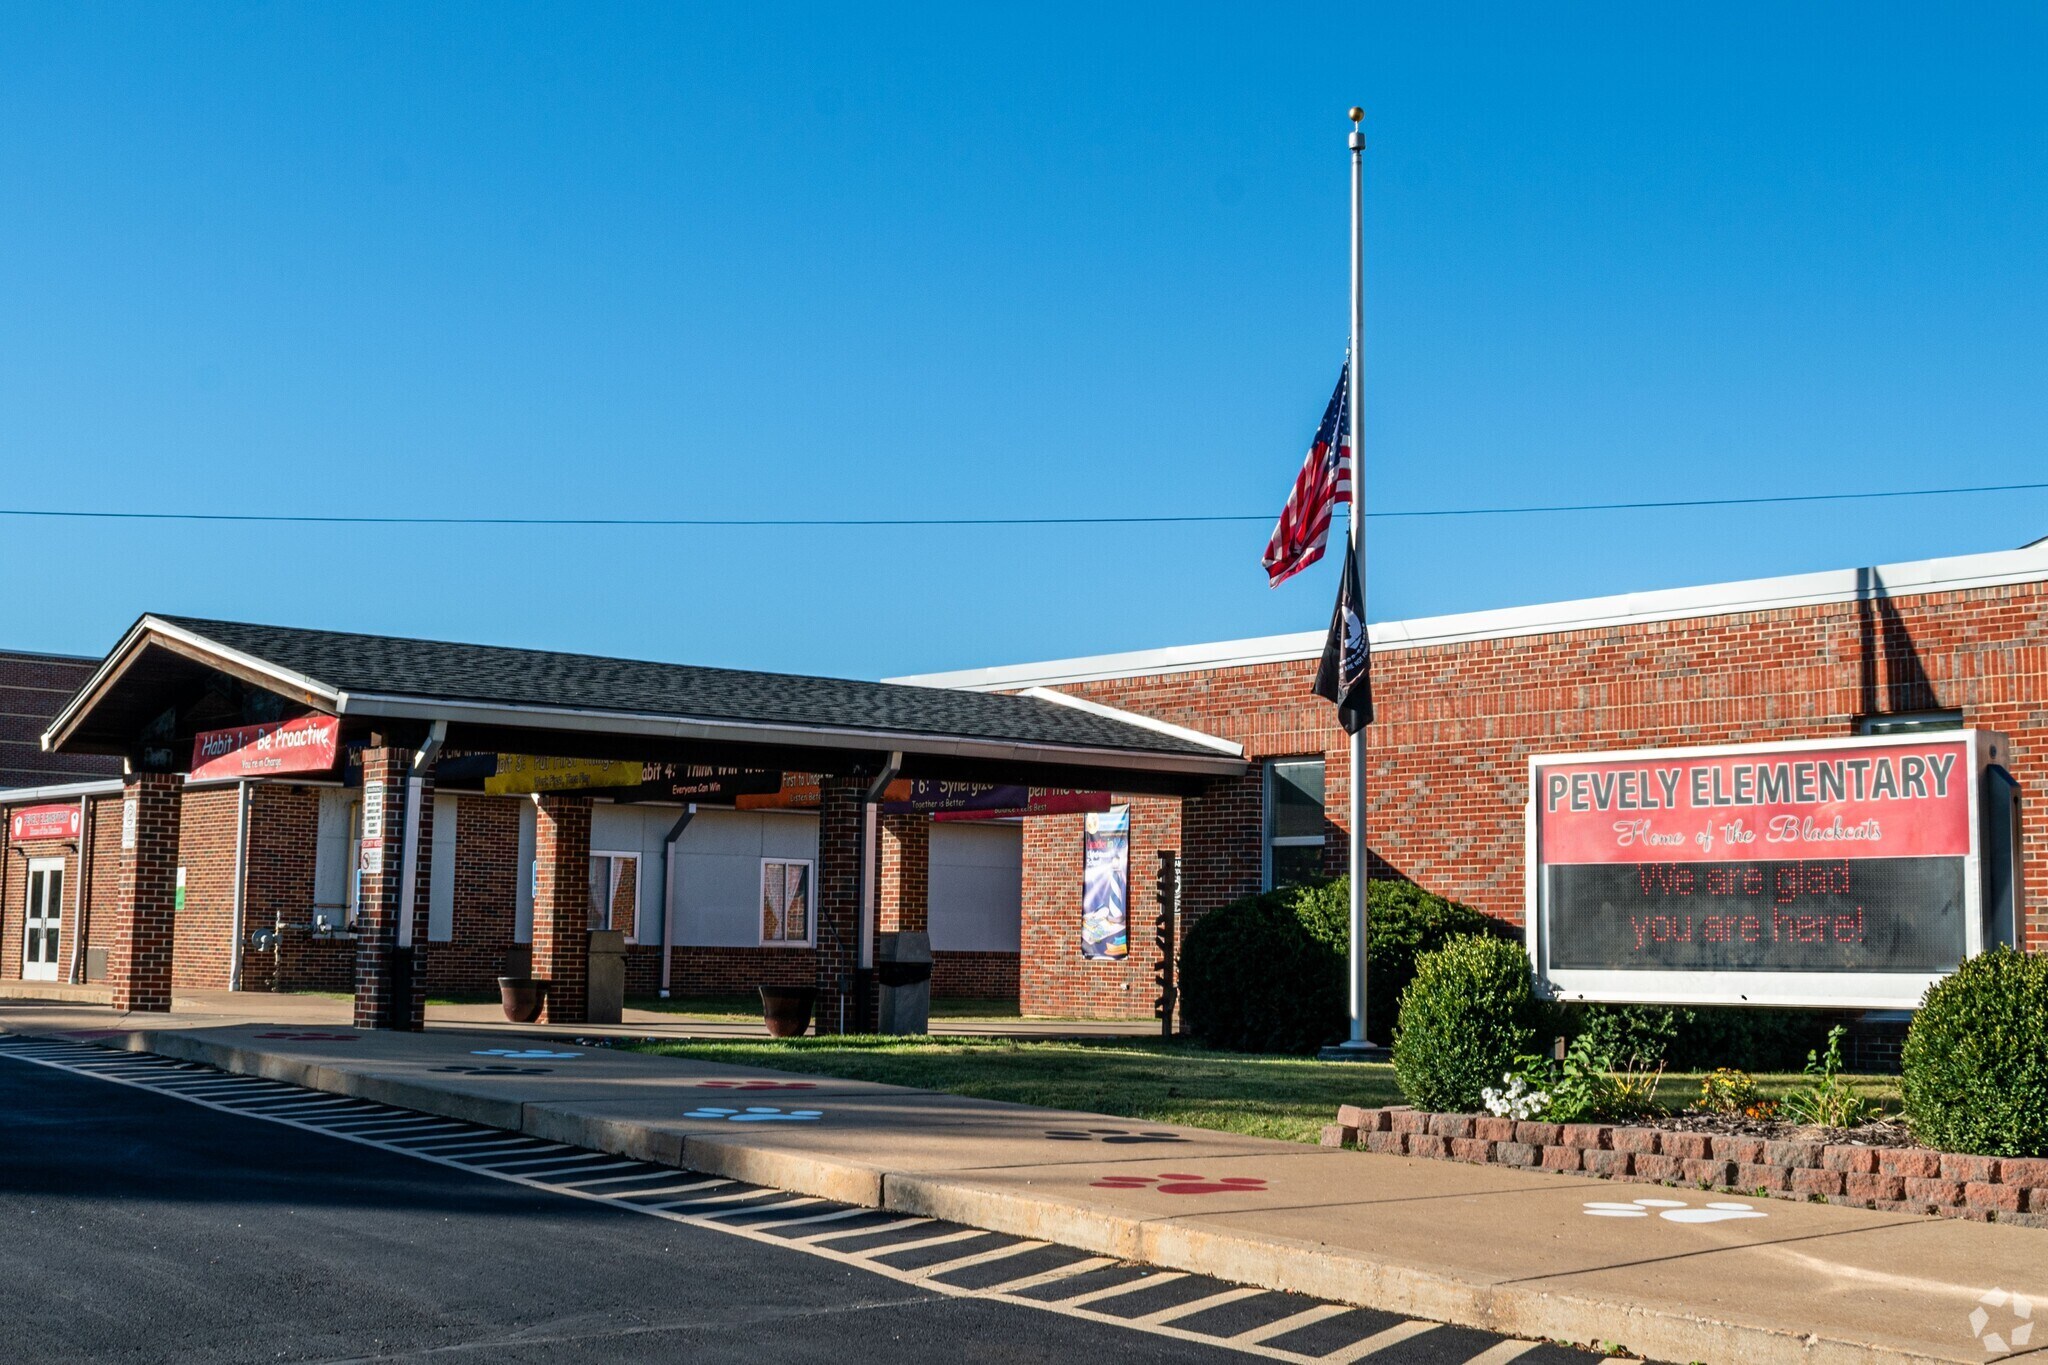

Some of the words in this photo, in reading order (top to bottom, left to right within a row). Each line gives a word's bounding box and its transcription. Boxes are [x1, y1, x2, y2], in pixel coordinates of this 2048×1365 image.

[201, 734, 233, 756] Habit
[237, 730, 248, 752] 1:
[257, 727, 271, 751] Be
[275, 722, 330, 748] Proactive
[264, 757, 282, 768] Charge
[641, 762, 662, 781] abit
[672, 784, 698, 797] Everyone
[698, 782, 708, 793] Can
[709, 781, 721, 792] Win
[1548, 768, 1681, 812] PEVELY
[1691, 753, 1956, 807] ELEMENTARY
[912, 799, 937, 810] Together
[945, 798, 966, 808] Better
[1034, 803, 1048, 812] Best
[1613, 819, 1686, 846] Home
[1696, 820, 1714, 853] of
[1719, 819, 1756, 845] the
[1766, 815, 1882, 843] Blackcats
[1637, 863, 1694, 896] We
[1707, 868, 1763, 895] are
[1777, 859, 1850, 903] glad
[1631, 916, 1692, 950] you
[1704, 916, 1761, 942] are
[1772, 905, 1864, 943] here!
